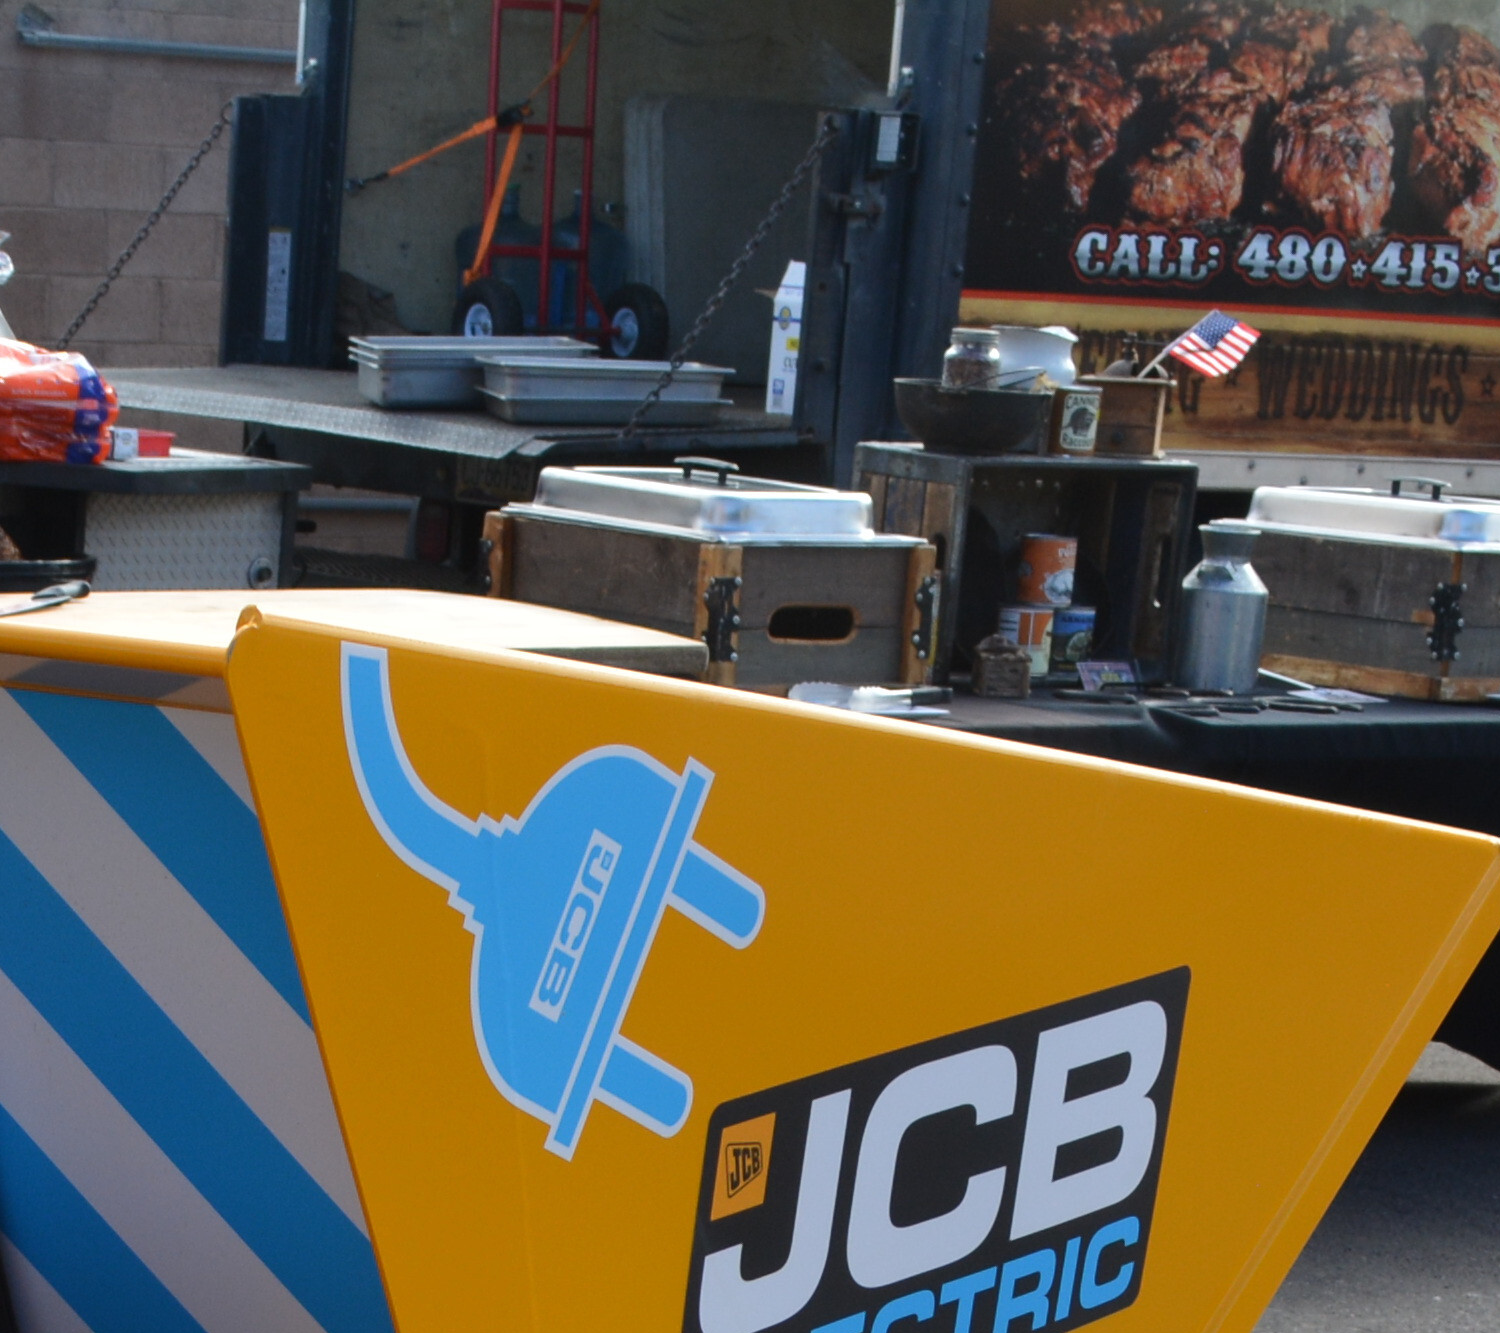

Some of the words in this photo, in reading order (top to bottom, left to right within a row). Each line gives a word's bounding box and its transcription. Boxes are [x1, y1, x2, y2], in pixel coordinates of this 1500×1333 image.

[1074, 230, 1221, 281] CALL:
[1255, 336, 1468, 425] WEDDINGS
[538, 844, 605, 1008] JCB
[730, 1147, 761, 1191] JCB
